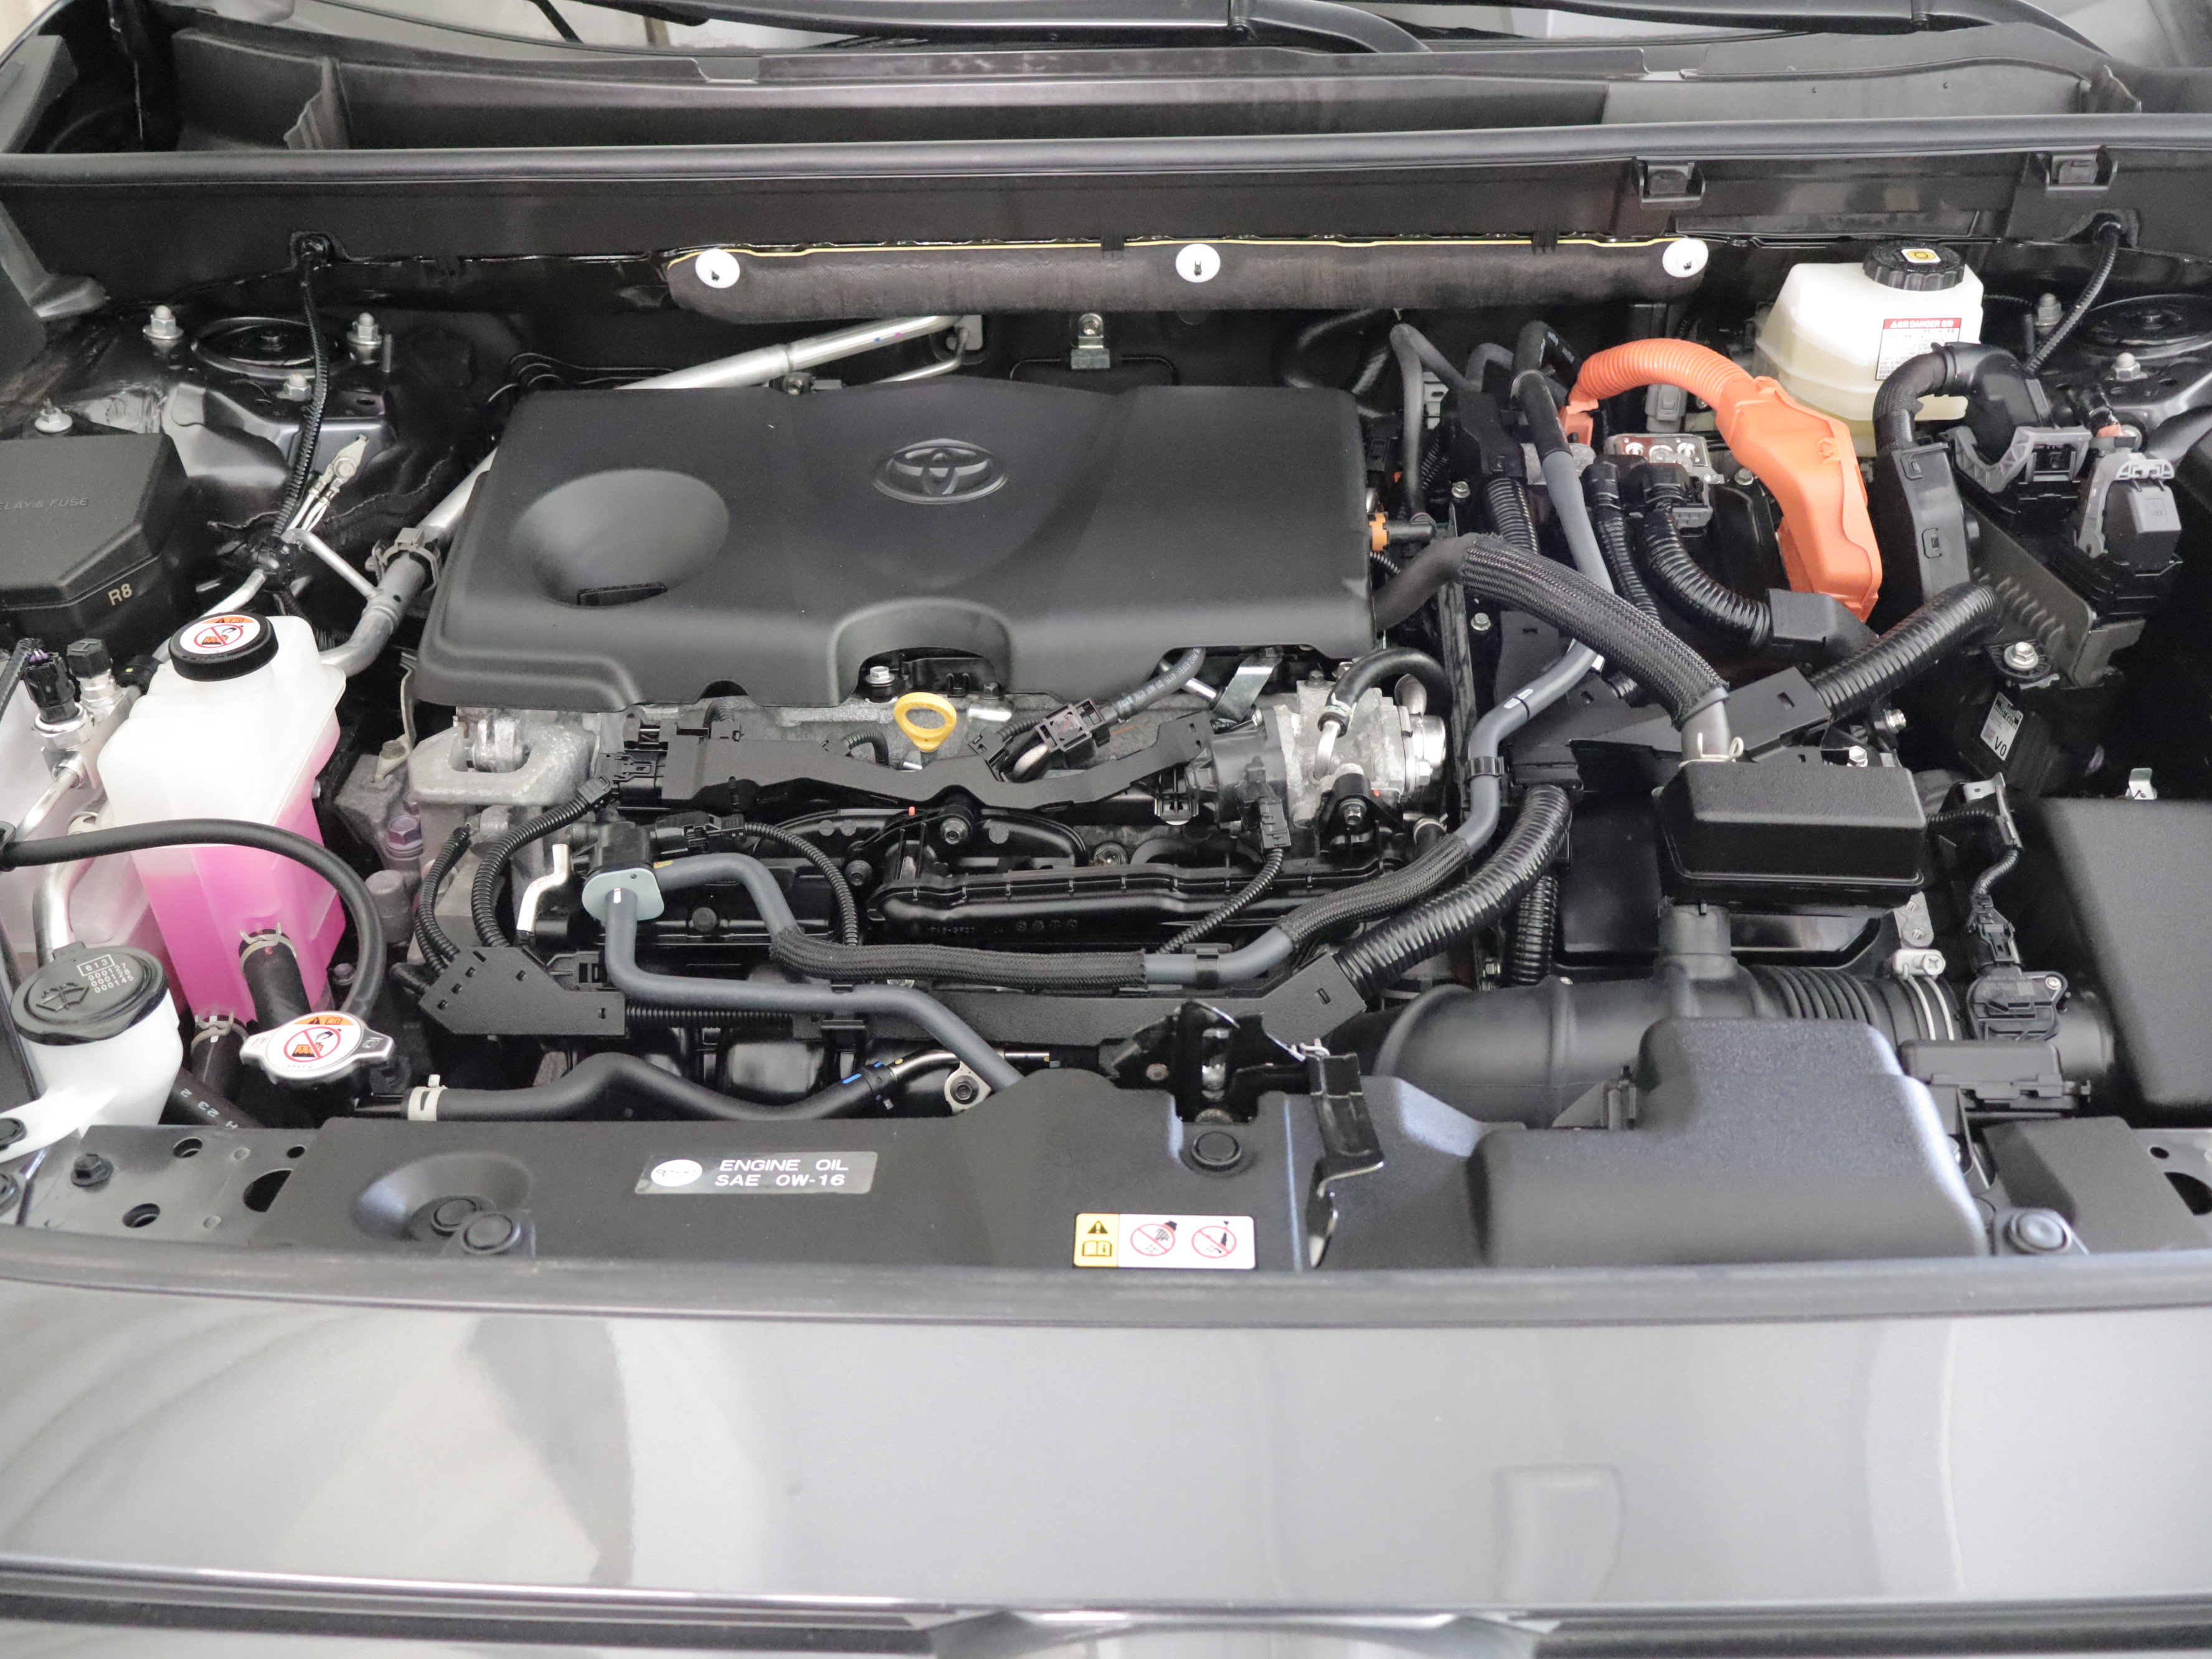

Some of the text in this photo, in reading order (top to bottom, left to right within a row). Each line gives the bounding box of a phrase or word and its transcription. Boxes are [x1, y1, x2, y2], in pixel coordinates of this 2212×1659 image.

[49, 498, 89, 507] FUSE
[108, 584, 132, 605] R8
[85, 959, 108, 971] e13
[88, 962, 126, 981] 000127
[91, 968, 131, 987] 000128
[94, 975, 134, 993] 000145
[180, 1088, 192, 1098] 2
[197, 1101, 220, 1118] 23
[719, 1159, 849, 1171] ENGINE OIL
[714, 1174, 761, 1187] SAE
